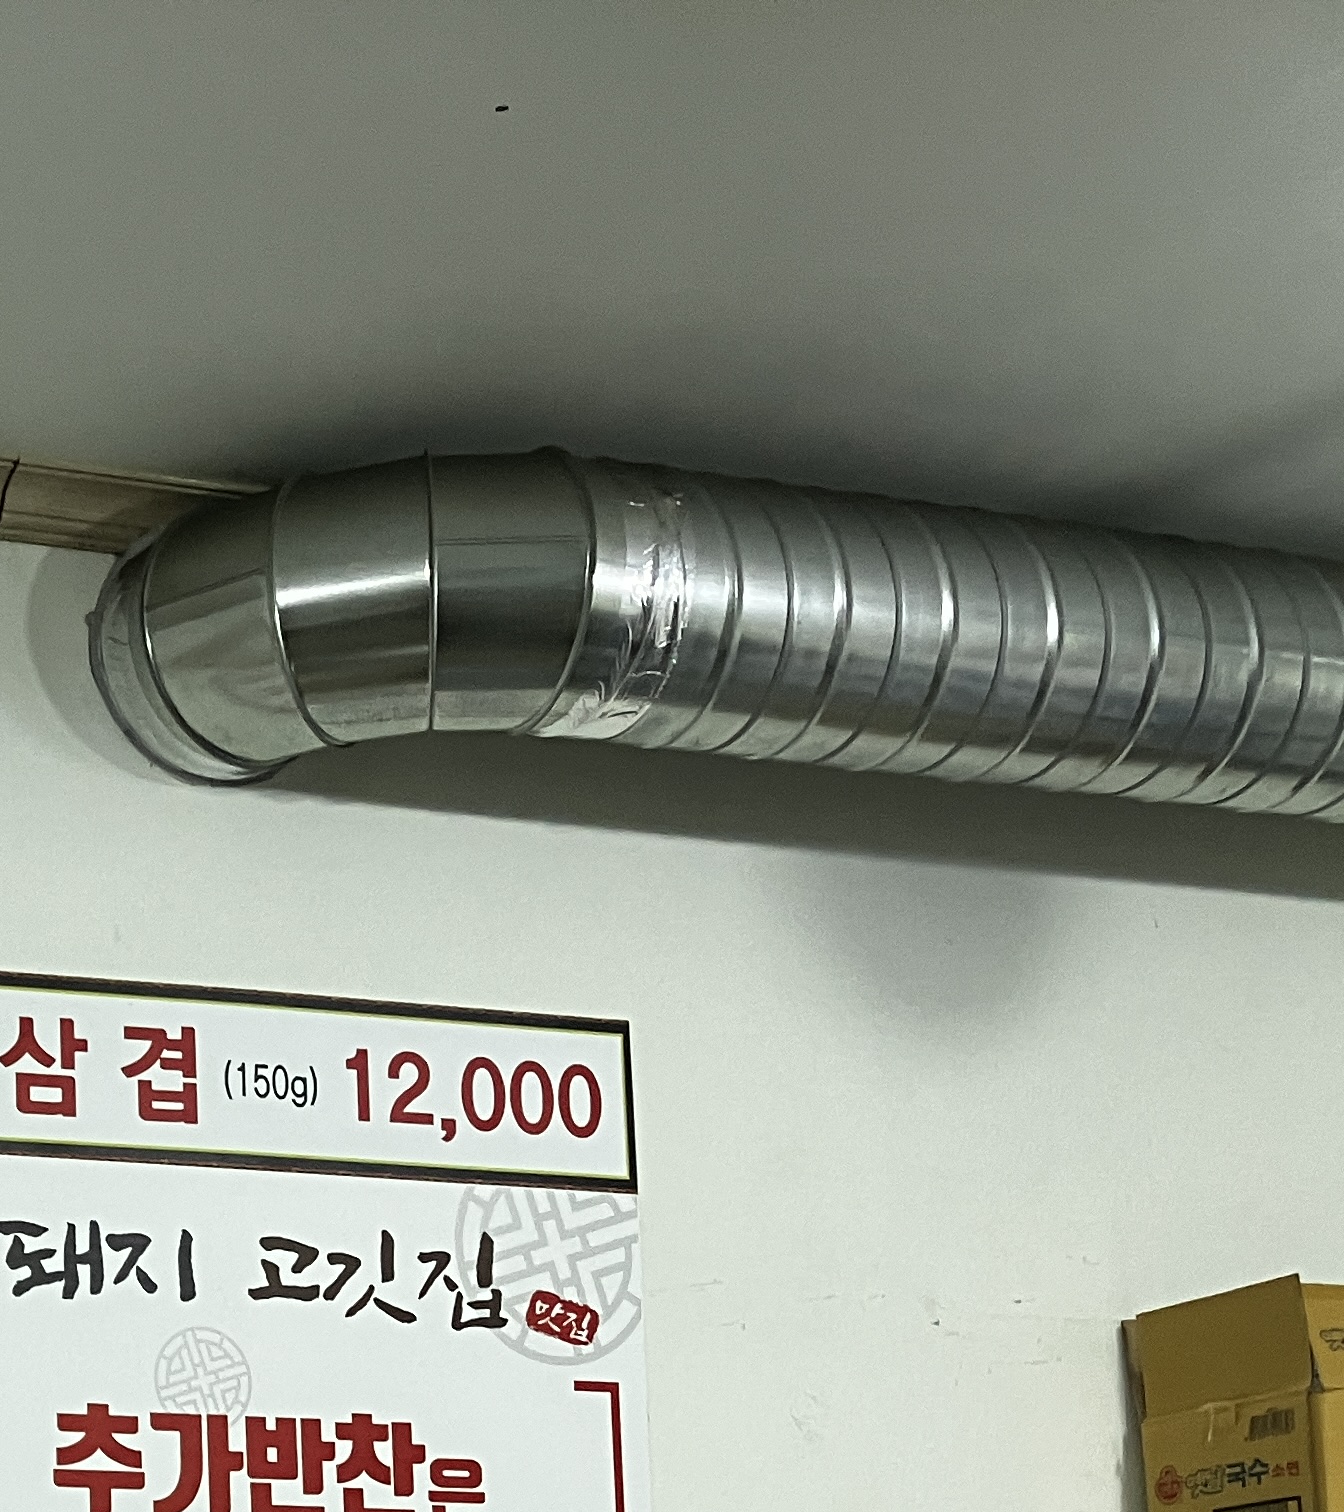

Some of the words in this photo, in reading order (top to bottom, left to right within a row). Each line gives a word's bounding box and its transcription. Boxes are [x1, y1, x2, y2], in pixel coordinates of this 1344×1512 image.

[224, 1059, 318, 1108] (150g)
[345, 1048, 602, 1143] 12,000
[247, 1229, 509, 1332] 고깃집
[535, 1300, 591, 1342] 맛집
